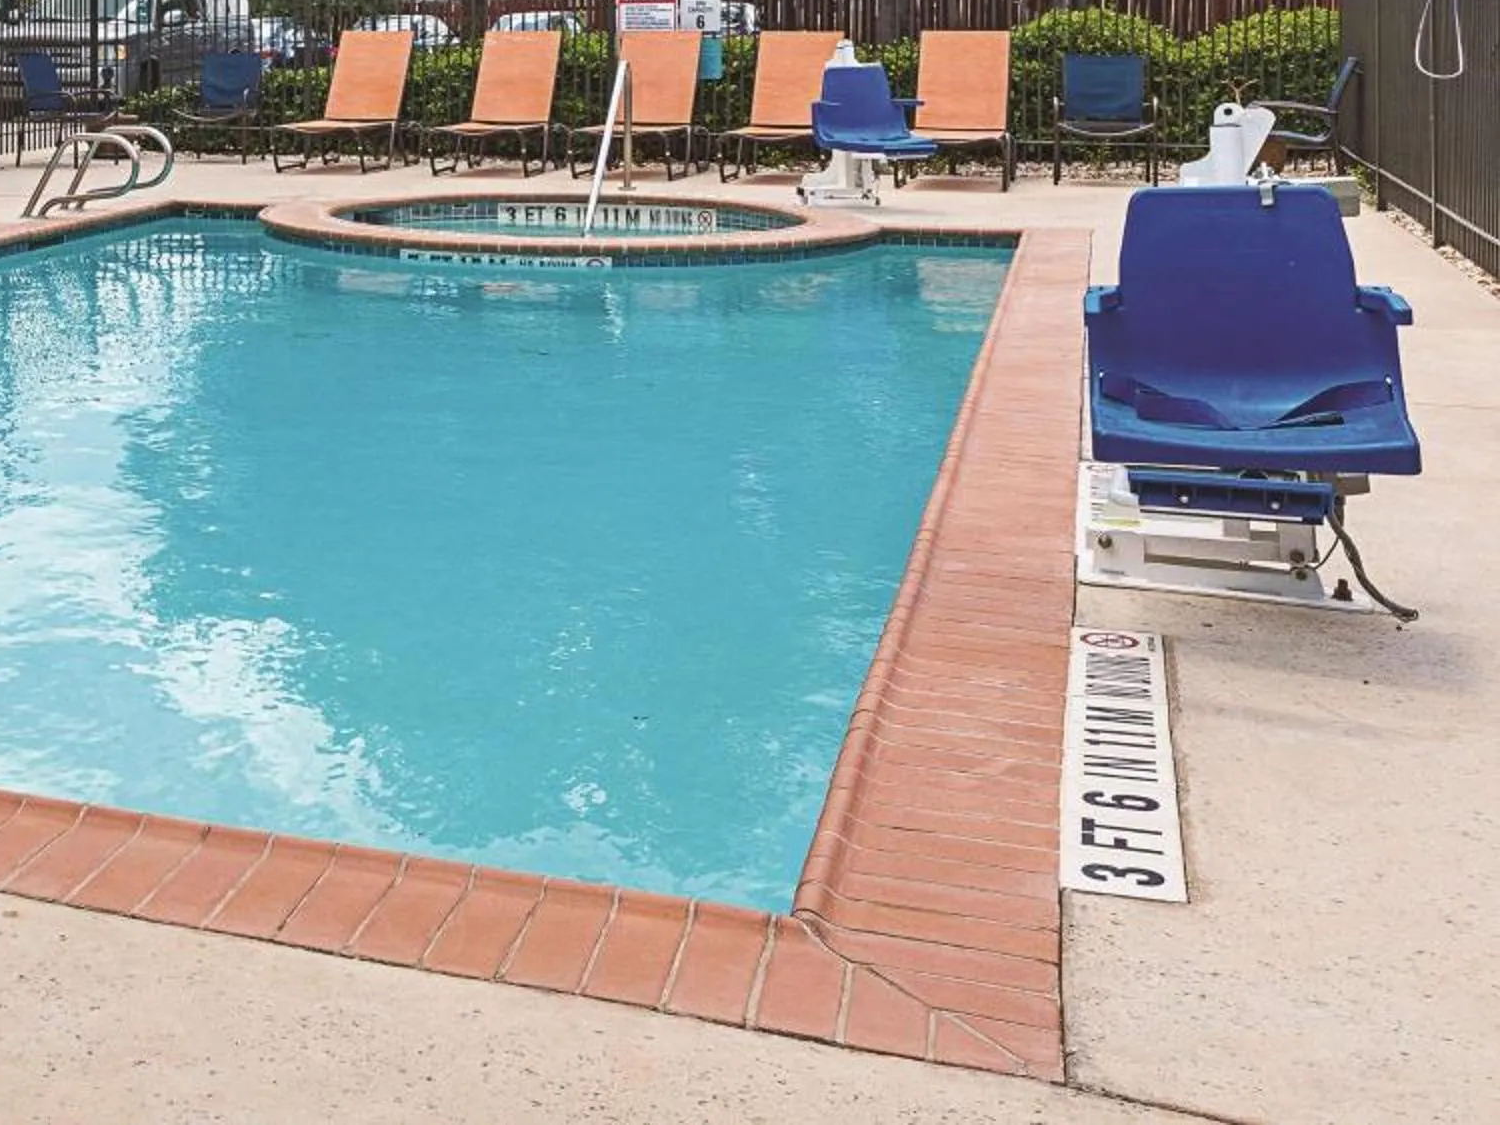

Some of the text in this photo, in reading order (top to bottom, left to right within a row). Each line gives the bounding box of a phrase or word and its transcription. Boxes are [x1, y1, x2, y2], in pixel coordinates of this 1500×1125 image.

[696, 15, 705, 30] 6
[506, 206, 516, 221] 3
[555, 206, 566, 221] 6
[1082, 791, 1160, 811] 6
[1081, 817, 1164, 855] FT
[1081, 863, 1165, 887] 3
